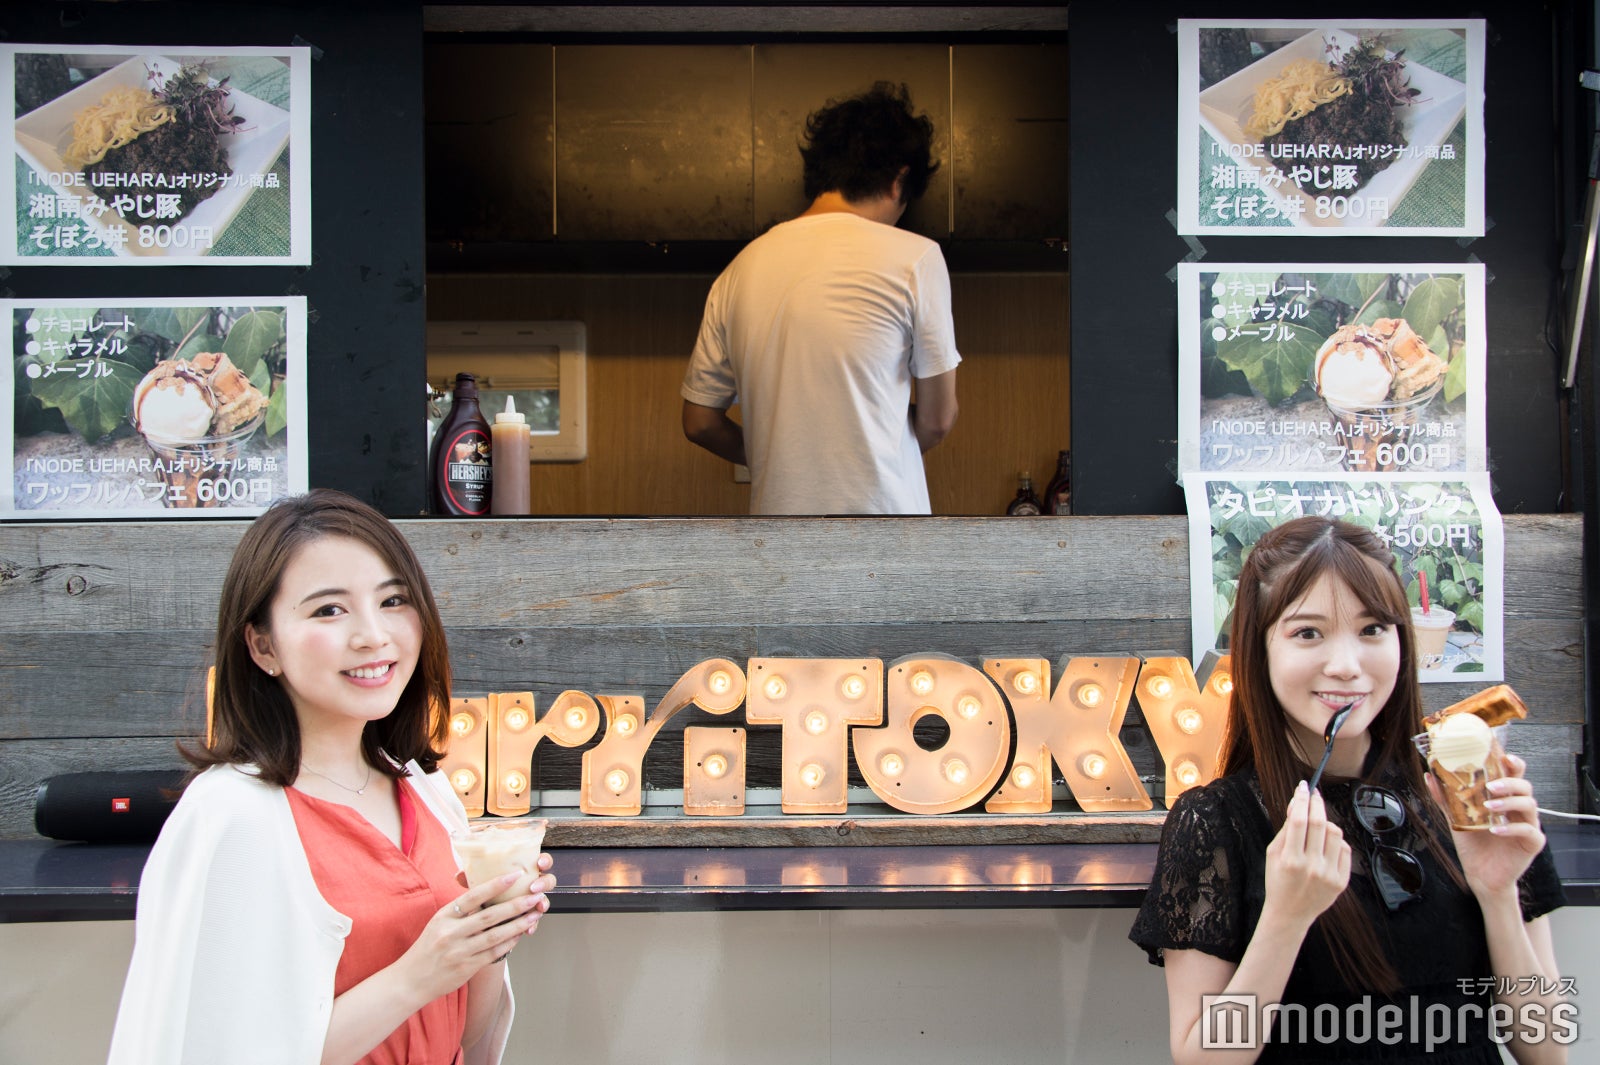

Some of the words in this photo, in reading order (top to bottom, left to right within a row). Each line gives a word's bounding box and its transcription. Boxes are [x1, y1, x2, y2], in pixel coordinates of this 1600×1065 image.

[1211, 164, 1357, 190] 湘南みやじ豚
[29, 193, 182, 219] 湘南みやじ豚
[1211, 196, 1306, 219] そぼろ丼
[1314, 196, 1389, 220] 800円
[29, 224, 128, 249] そぼろ丼
[138, 225, 214, 249] 800円
[1212, 442, 1367, 466] ワッフルパフェ
[1376, 443, 1450, 466] 600円
[27, 478, 187, 505] ワッフルパフェ
[197, 478, 272, 502] 600円
[1217, 487, 1462, 520] タピオカドリンク
